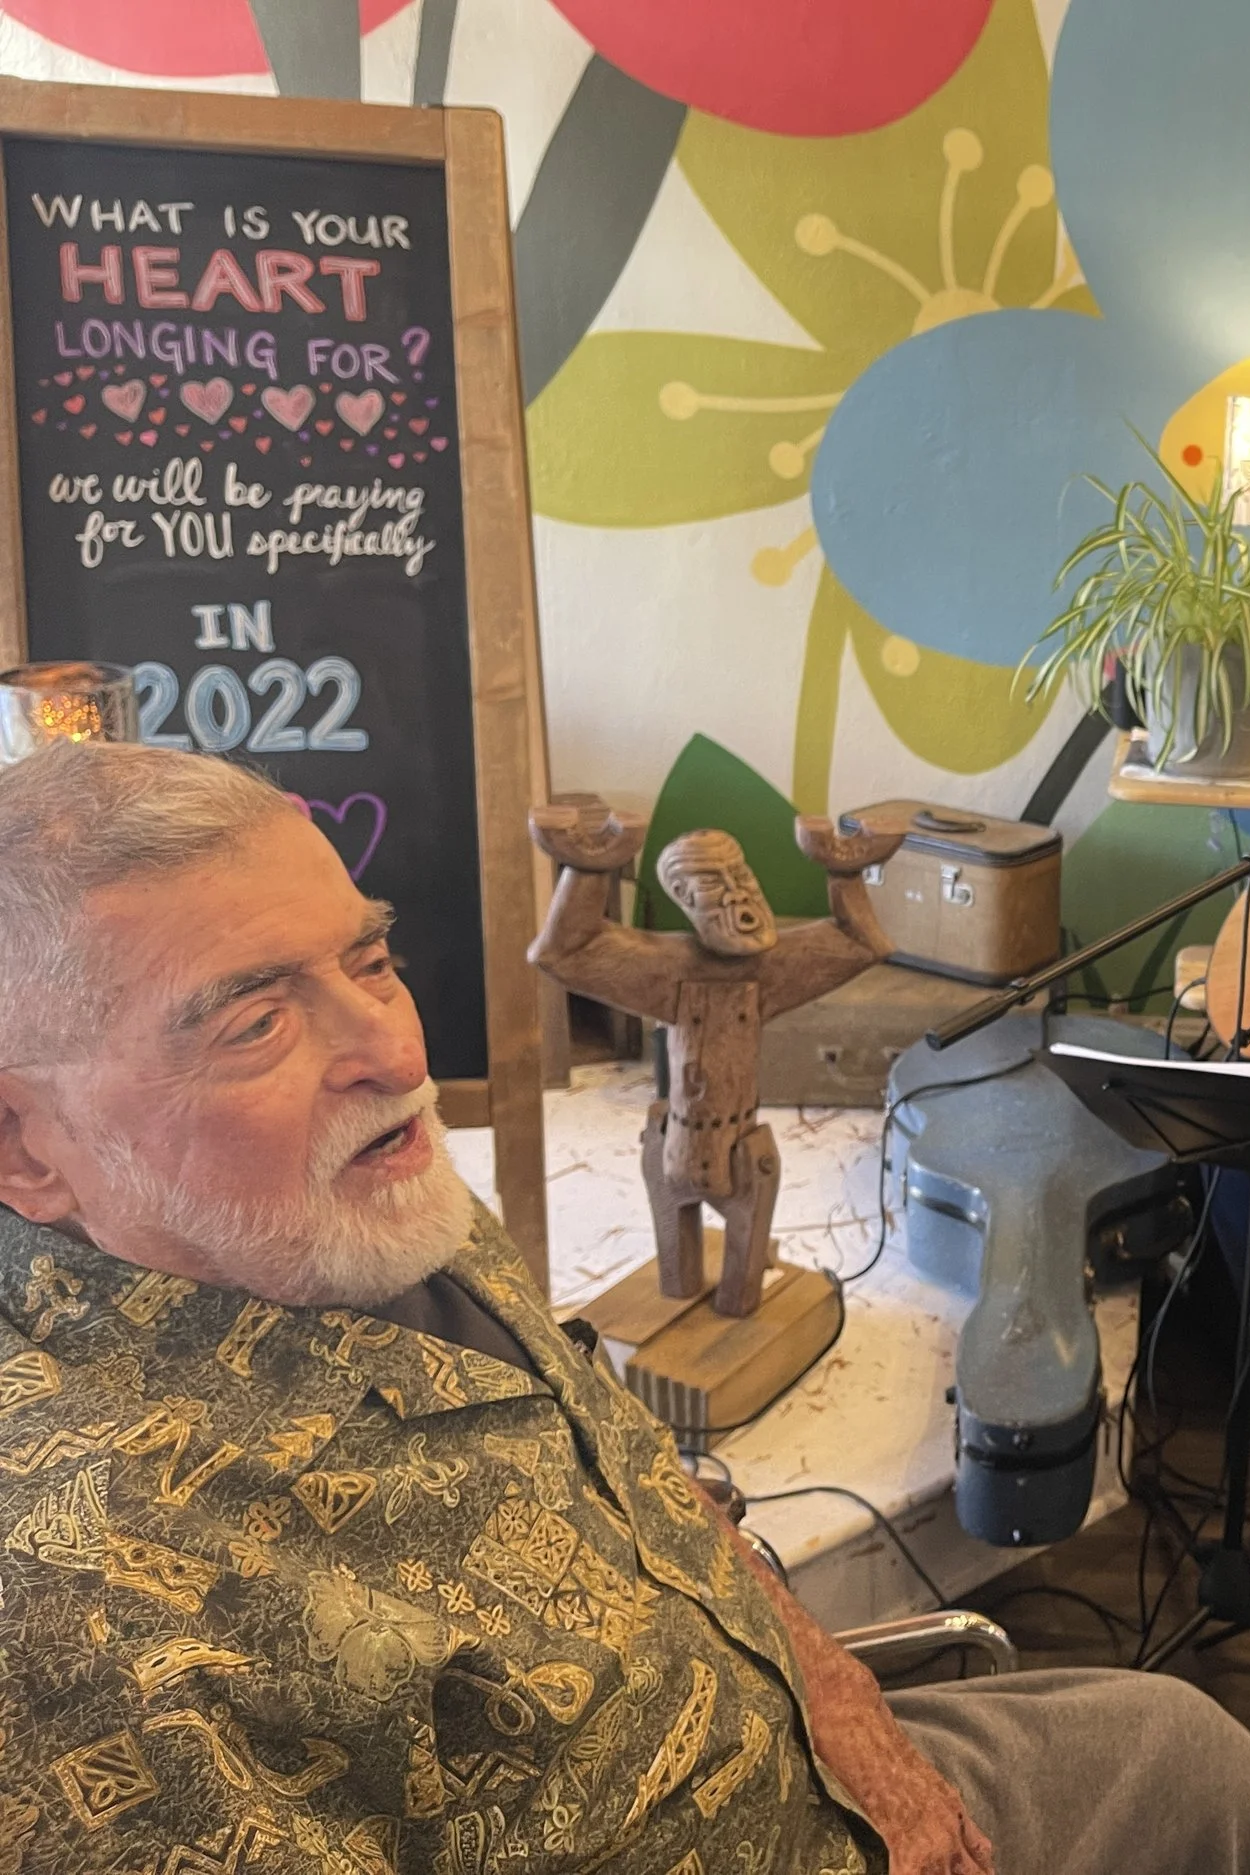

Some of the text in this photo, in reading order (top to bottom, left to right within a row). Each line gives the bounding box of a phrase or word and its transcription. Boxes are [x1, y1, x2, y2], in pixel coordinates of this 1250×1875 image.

[31, 192, 412, 250] WHAT IS YOUR
[59, 241, 381, 322] HEART
[54, 319, 279, 380] LONGING
[48, 457, 426, 530] we will be praying
[75, 510, 436, 577] for YOU specifically
[191, 599, 277, 653] IN
[131, 655, 370, 752] 2022
